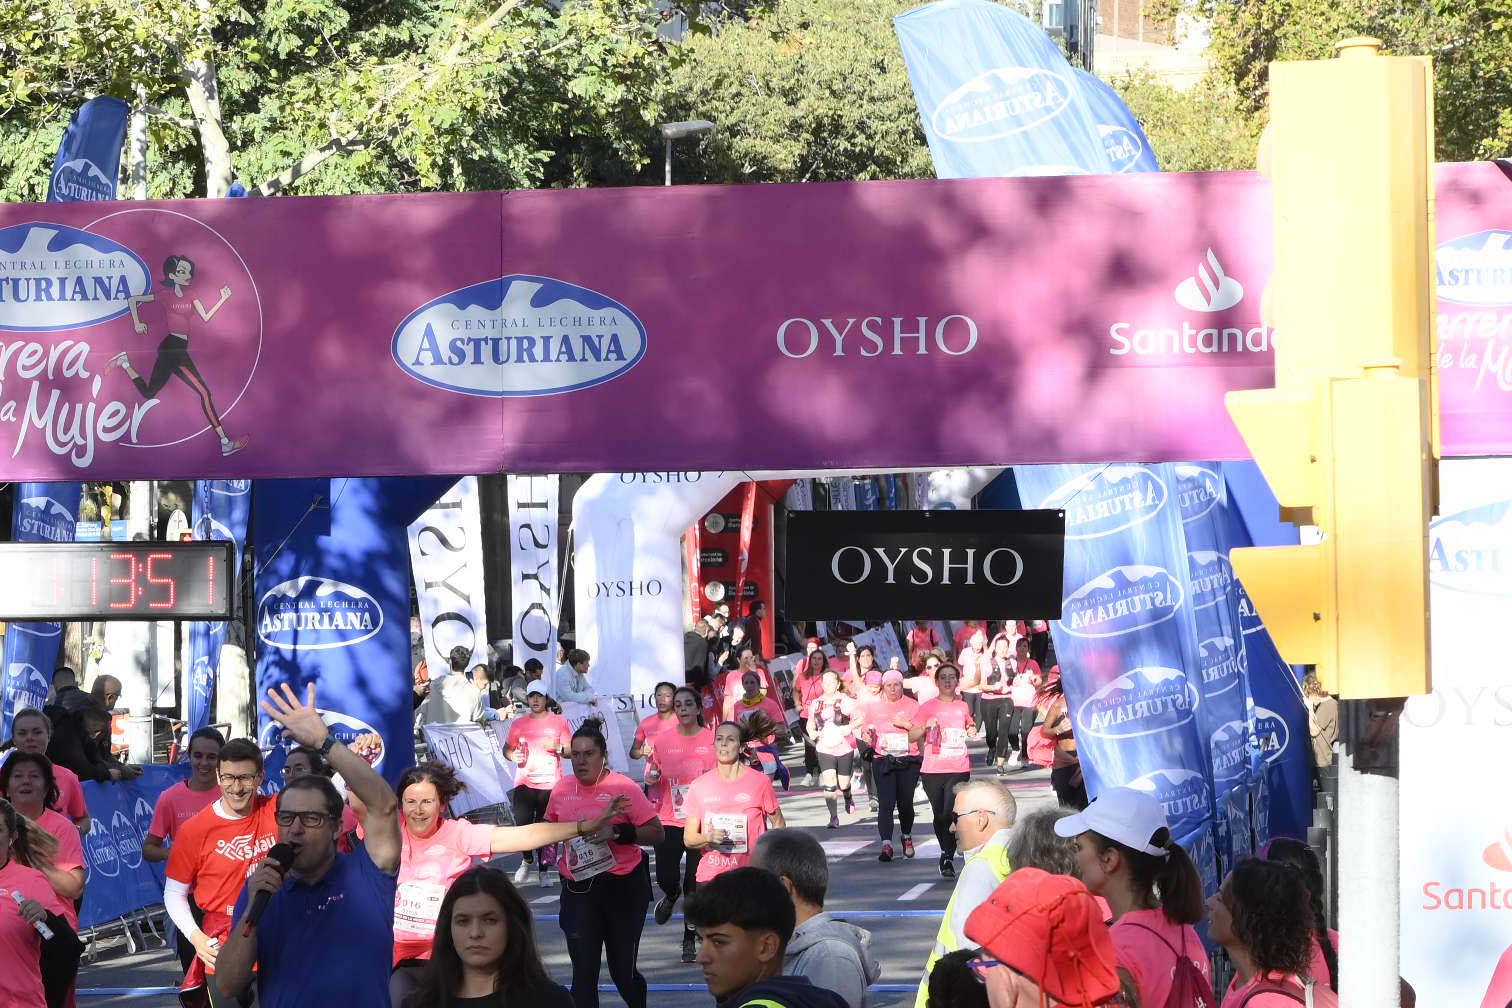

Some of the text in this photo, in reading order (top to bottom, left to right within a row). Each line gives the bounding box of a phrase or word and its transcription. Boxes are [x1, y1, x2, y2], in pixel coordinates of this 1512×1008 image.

[54, 257, 126, 271] LECHERA
[451, 315, 619, 330] CENTRAL LECHERA
[777, 314, 979, 359] OYSHO
[411, 323, 627, 367] ASTURIANA
[11, 374, 161, 468] Mujer
[830, 546, 1024, 586] OYSHO
[260, 606, 374, 634] ASTURIANA
[708, 854, 739, 866] SUMA
